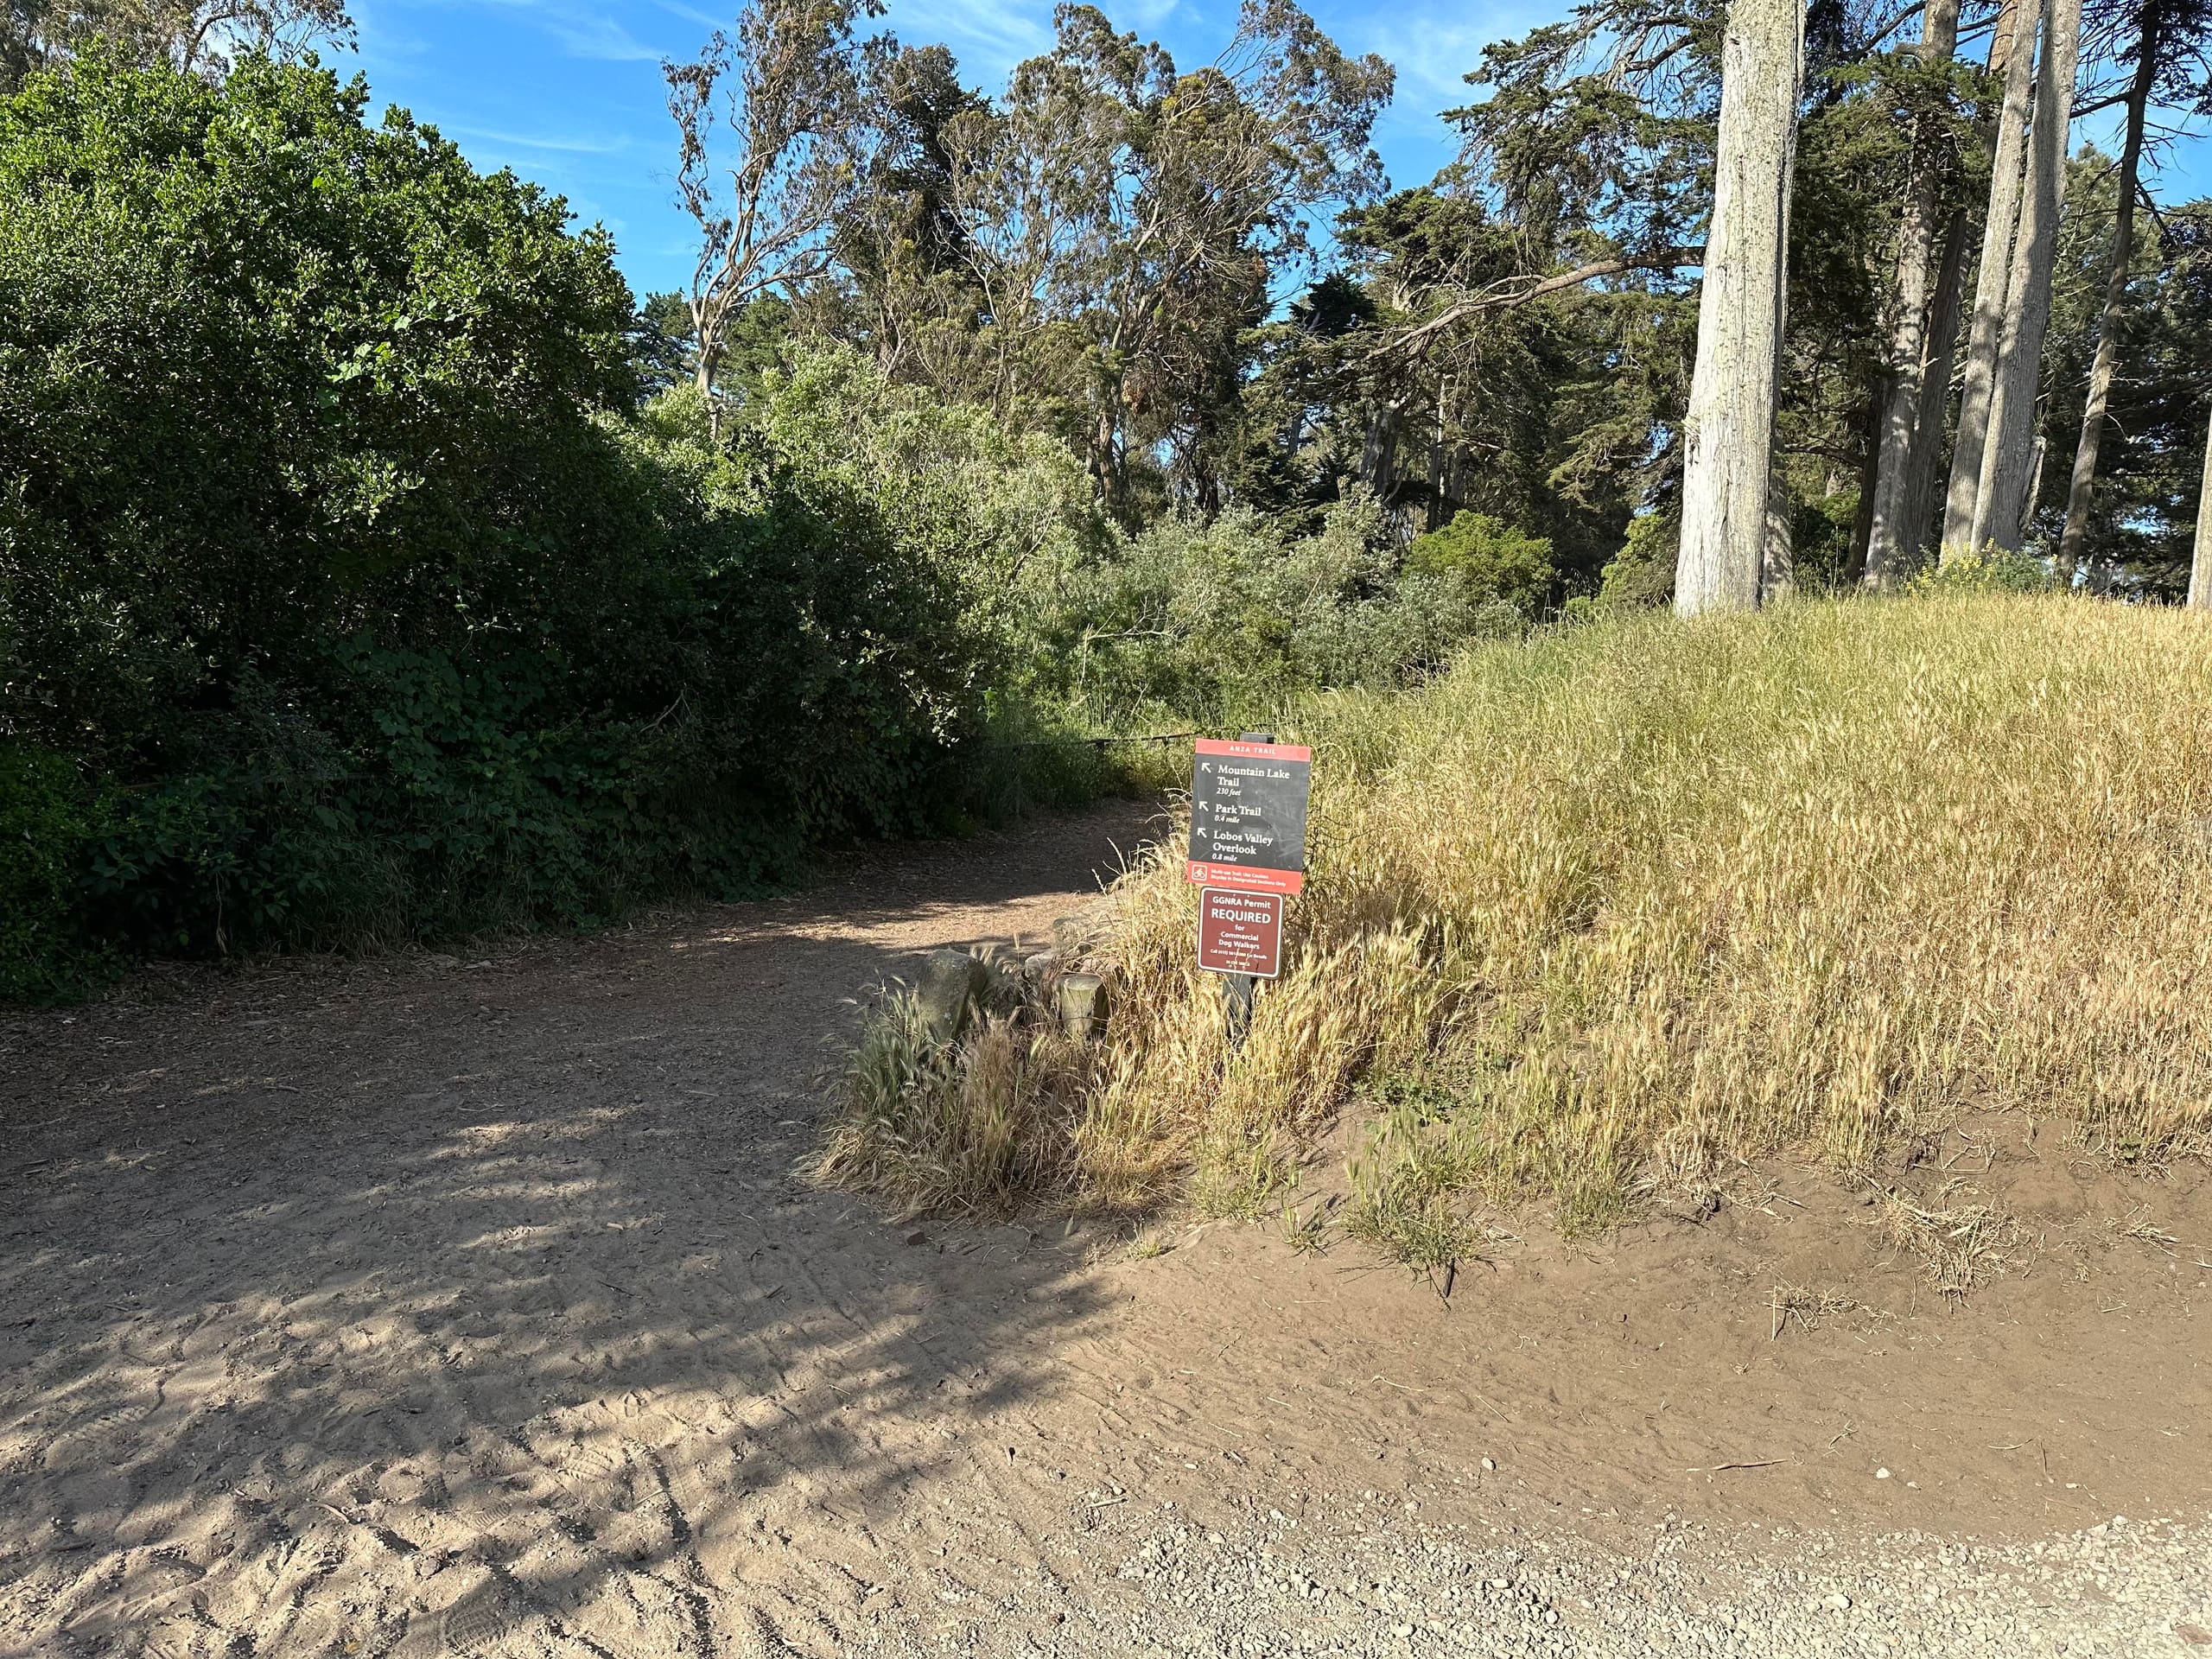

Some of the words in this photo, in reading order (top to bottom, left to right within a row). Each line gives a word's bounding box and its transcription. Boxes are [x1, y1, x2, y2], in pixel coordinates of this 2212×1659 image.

[1217, 765, 1264, 777] Mountain
[1267, 769, 1290, 779] Lake
[1217, 777, 1239, 786] Trail
[1216, 804, 1237, 814] Park
[1239, 805, 1262, 817] Trail
[1213, 830, 1243, 842] Lobos
[1244, 833, 1273, 847] Valley
[1212, 842, 1256, 855] Overlook
[1212, 896, 1243, 906] GGNRA
[1244, 899, 1271, 909] Permit
[1211, 908, 1271, 924] REQUIRED
[1220, 931, 1259, 941] Commercial
[1218, 939, 1232, 948] Dog
[1233, 941, 1260, 950] Walkers
